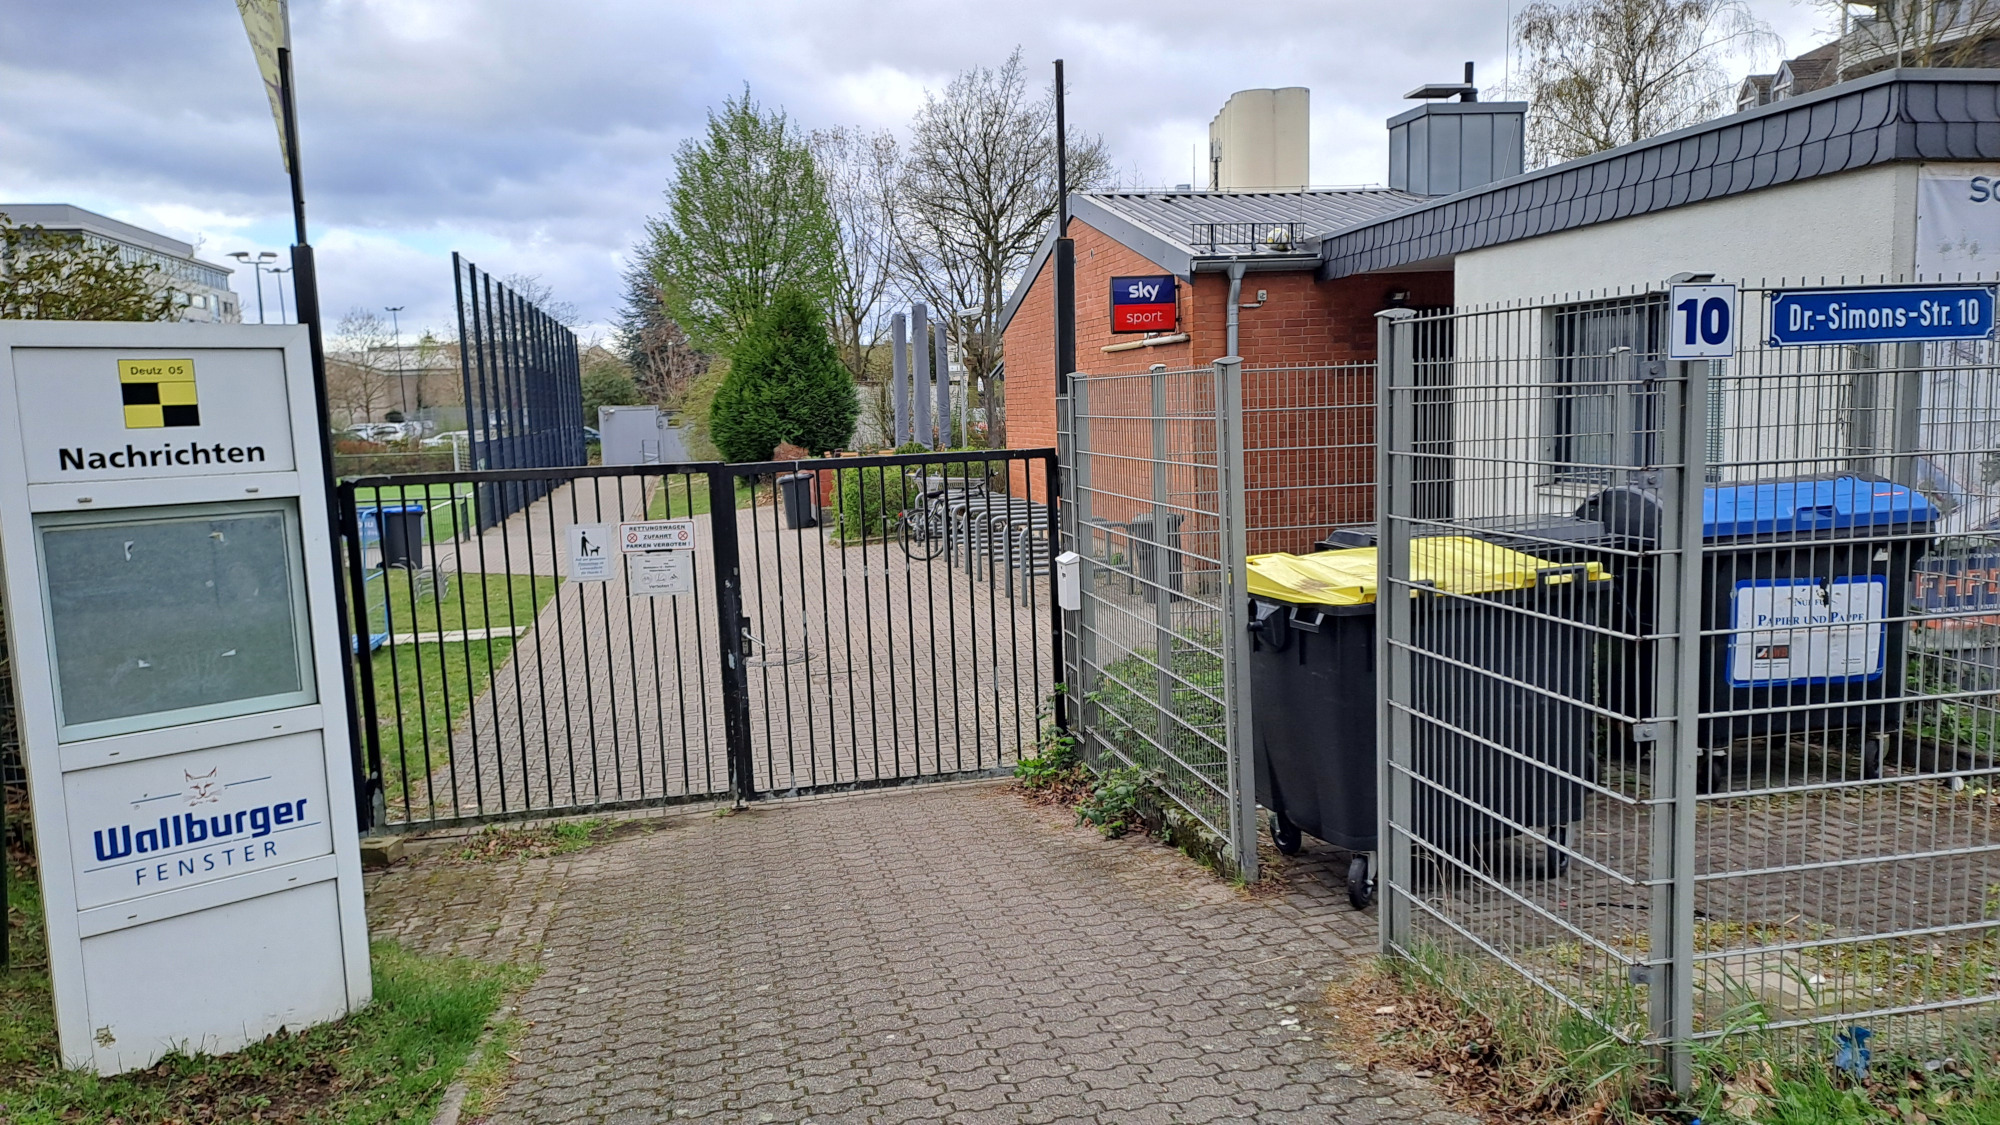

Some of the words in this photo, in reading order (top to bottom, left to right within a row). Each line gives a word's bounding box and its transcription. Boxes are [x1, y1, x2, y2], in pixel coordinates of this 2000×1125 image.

[1128, 281, 1160, 302] sky
[1126, 311, 1164, 325] sport
[1677, 297, 1730, 345] 10
[1789, 300, 1952, 332] Dr.-Simons-Str.
[1958, 299, 1980, 325] 10
[130, 366, 162, 376] Deutz
[168, 366, 184, 375] 05
[59, 442, 266, 471] Nachrichten
[94, 798, 307, 862] Wallburger
[136, 841, 277, 886] FENSTER
